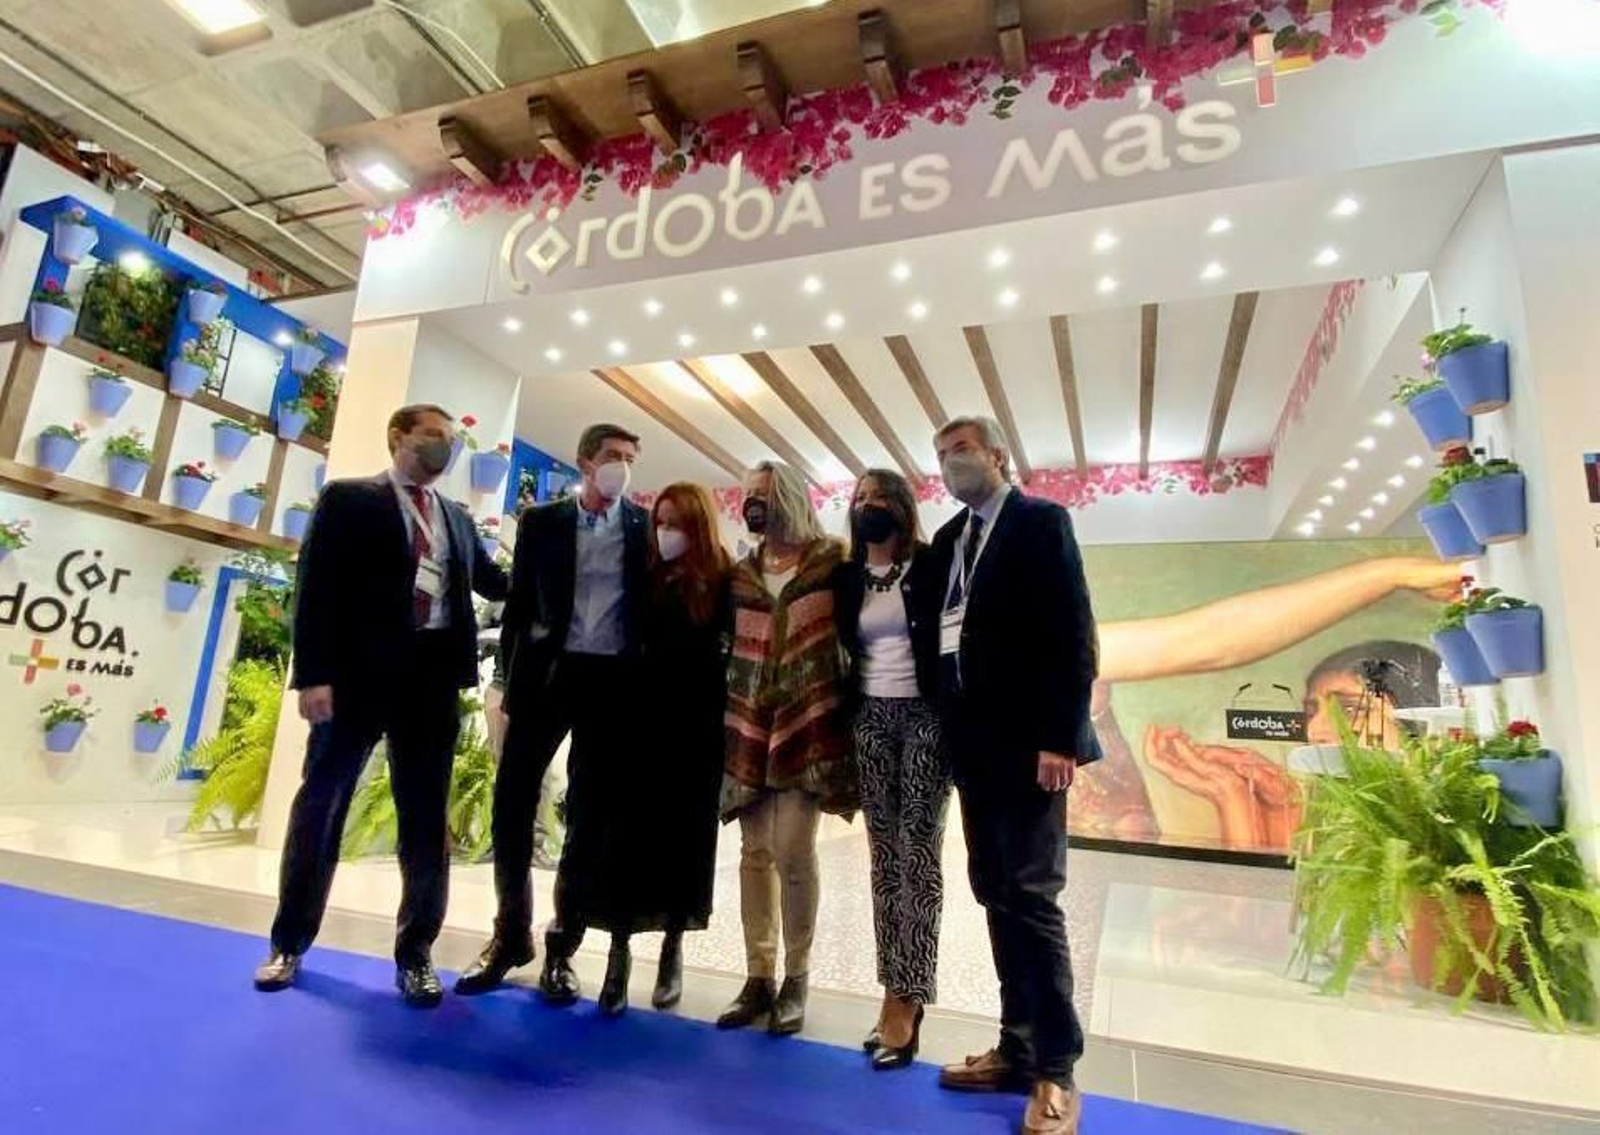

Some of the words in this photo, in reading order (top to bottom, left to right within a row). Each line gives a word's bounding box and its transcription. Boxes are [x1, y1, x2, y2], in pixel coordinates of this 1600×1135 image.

[858, 153, 952, 221] ES
[985, 84, 1242, 199] Más
[66, 658, 87, 672] ES
[90, 659, 135, 677] Más
